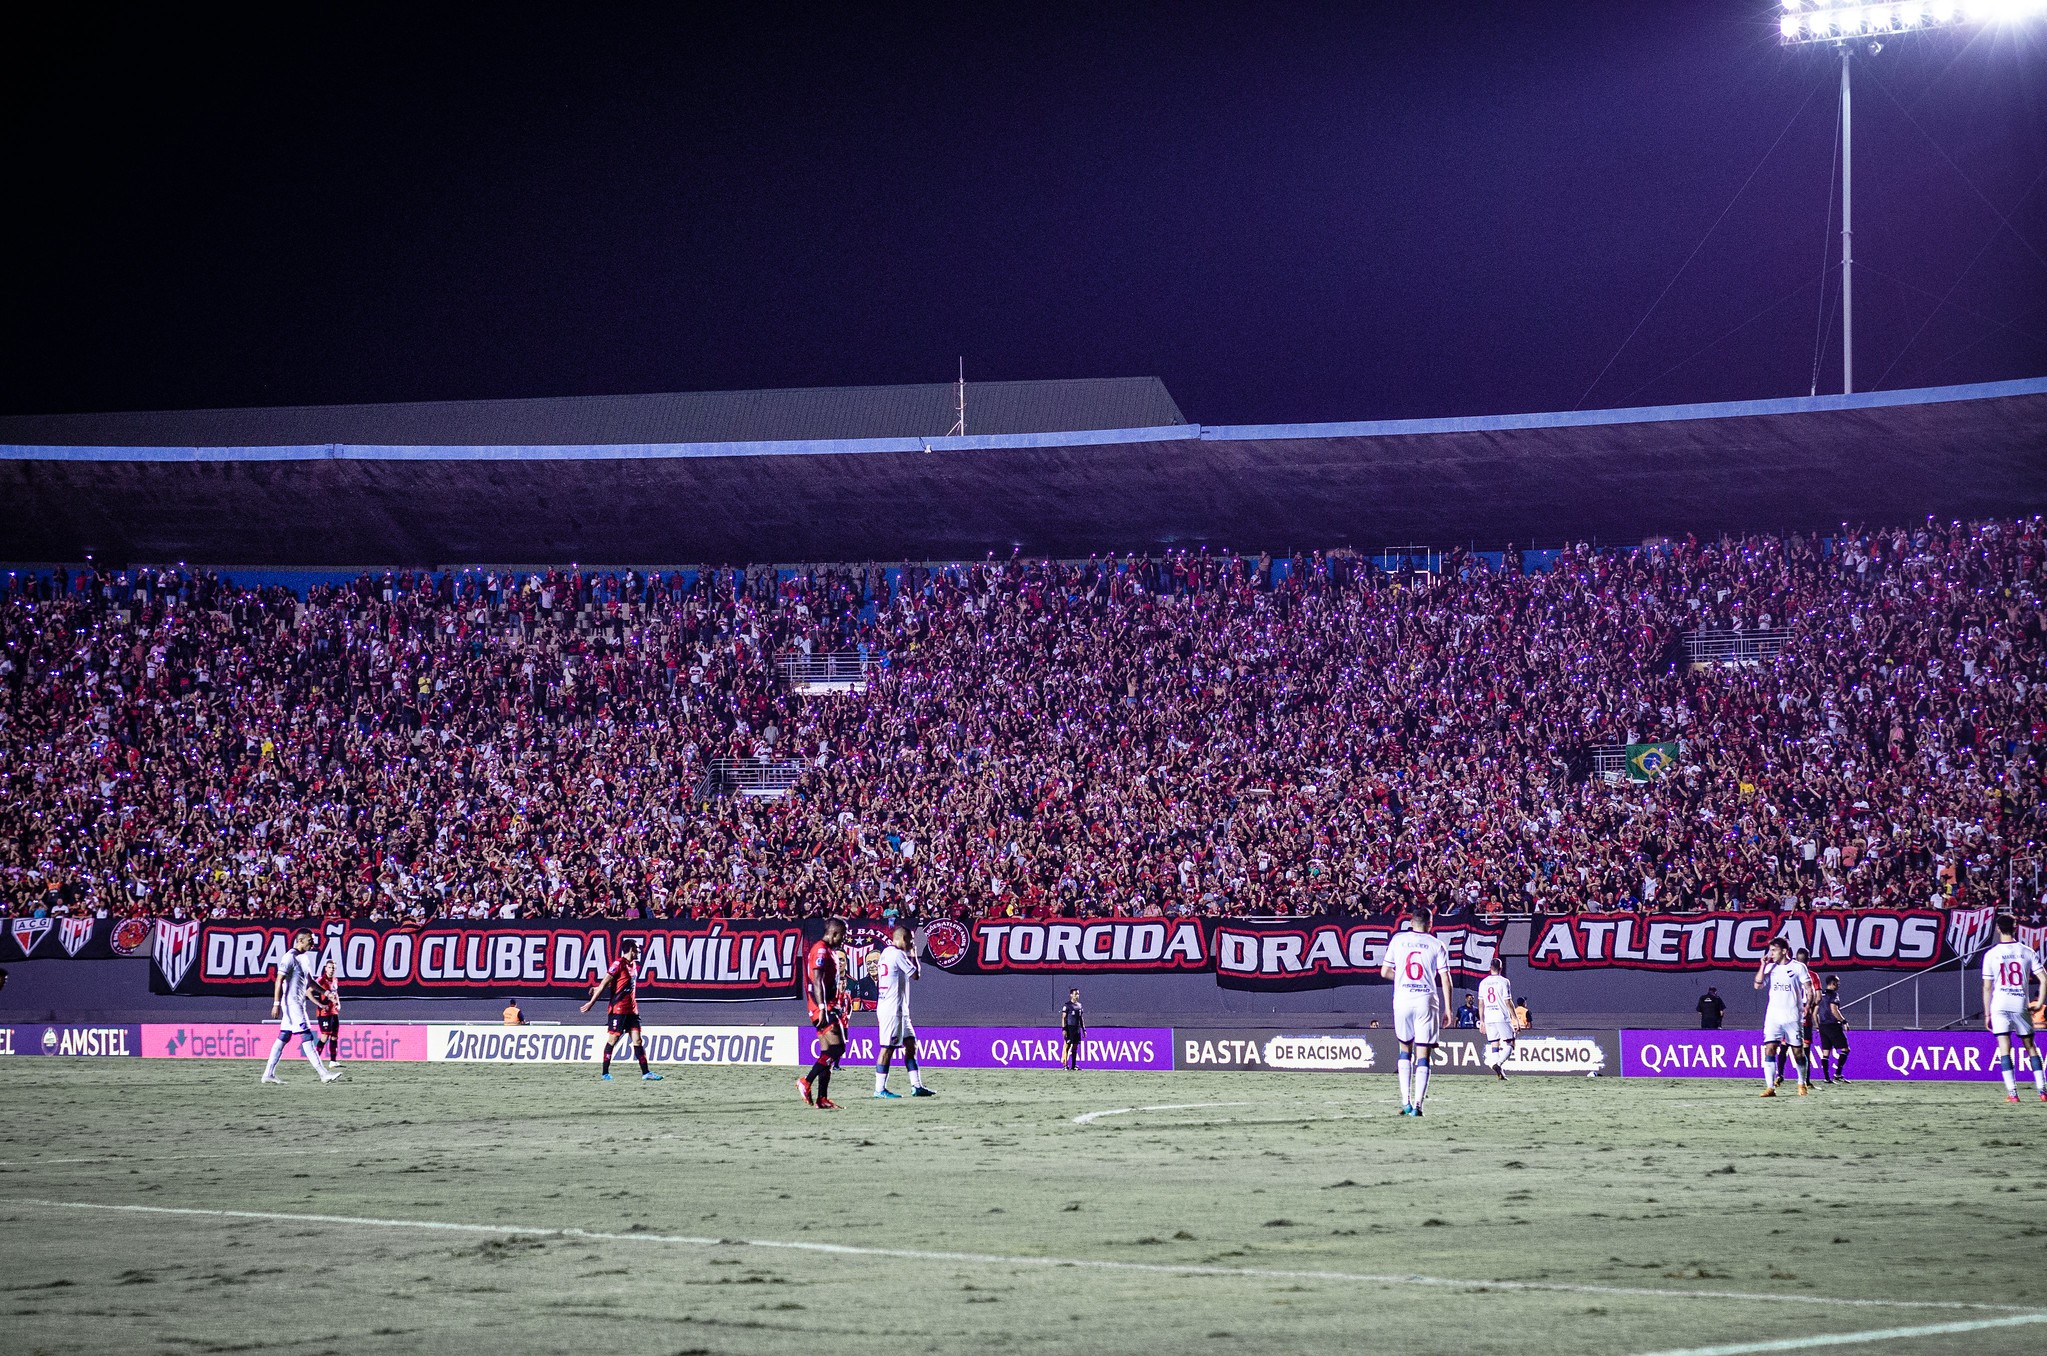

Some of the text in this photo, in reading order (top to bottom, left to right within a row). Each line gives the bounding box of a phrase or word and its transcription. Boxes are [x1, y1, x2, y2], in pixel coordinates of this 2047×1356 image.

[18, 918, 49, 930] ACG
[1947, 907, 1995, 964] ACG
[153, 917, 199, 988] ACG
[979, 924, 1203, 962] TORCIDA
[1220, 919, 1498, 973] DRAGES
[1536, 917, 1940, 960] ATLETICANOS
[384, 935, 412, 979] O
[420, 935, 547, 980] CLUBE
[555, 936, 609, 980] DA
[1405, 950, 1424, 980] 6
[2000, 961, 2023, 986] 18
[1487, 986, 1496, 1004] 8
[59, 1028, 129, 1056] AMSTEL
[191, 1029, 261, 1057] betfair
[445, 1030, 594, 1061] BRIDGESTONE
[889, 1039, 961, 1060] WAYS
[991, 1039, 1059, 1065] QATAR
[1185, 1040, 1362, 1064] BASTA DE RACISMO
[1410, 1041, 1481, 1067] STA
[1520, 1047, 1591, 1063] RACISMO
[1640, 1044, 1726, 1073] QATAR
[1886, 1046, 1982, 1076] QATAR
